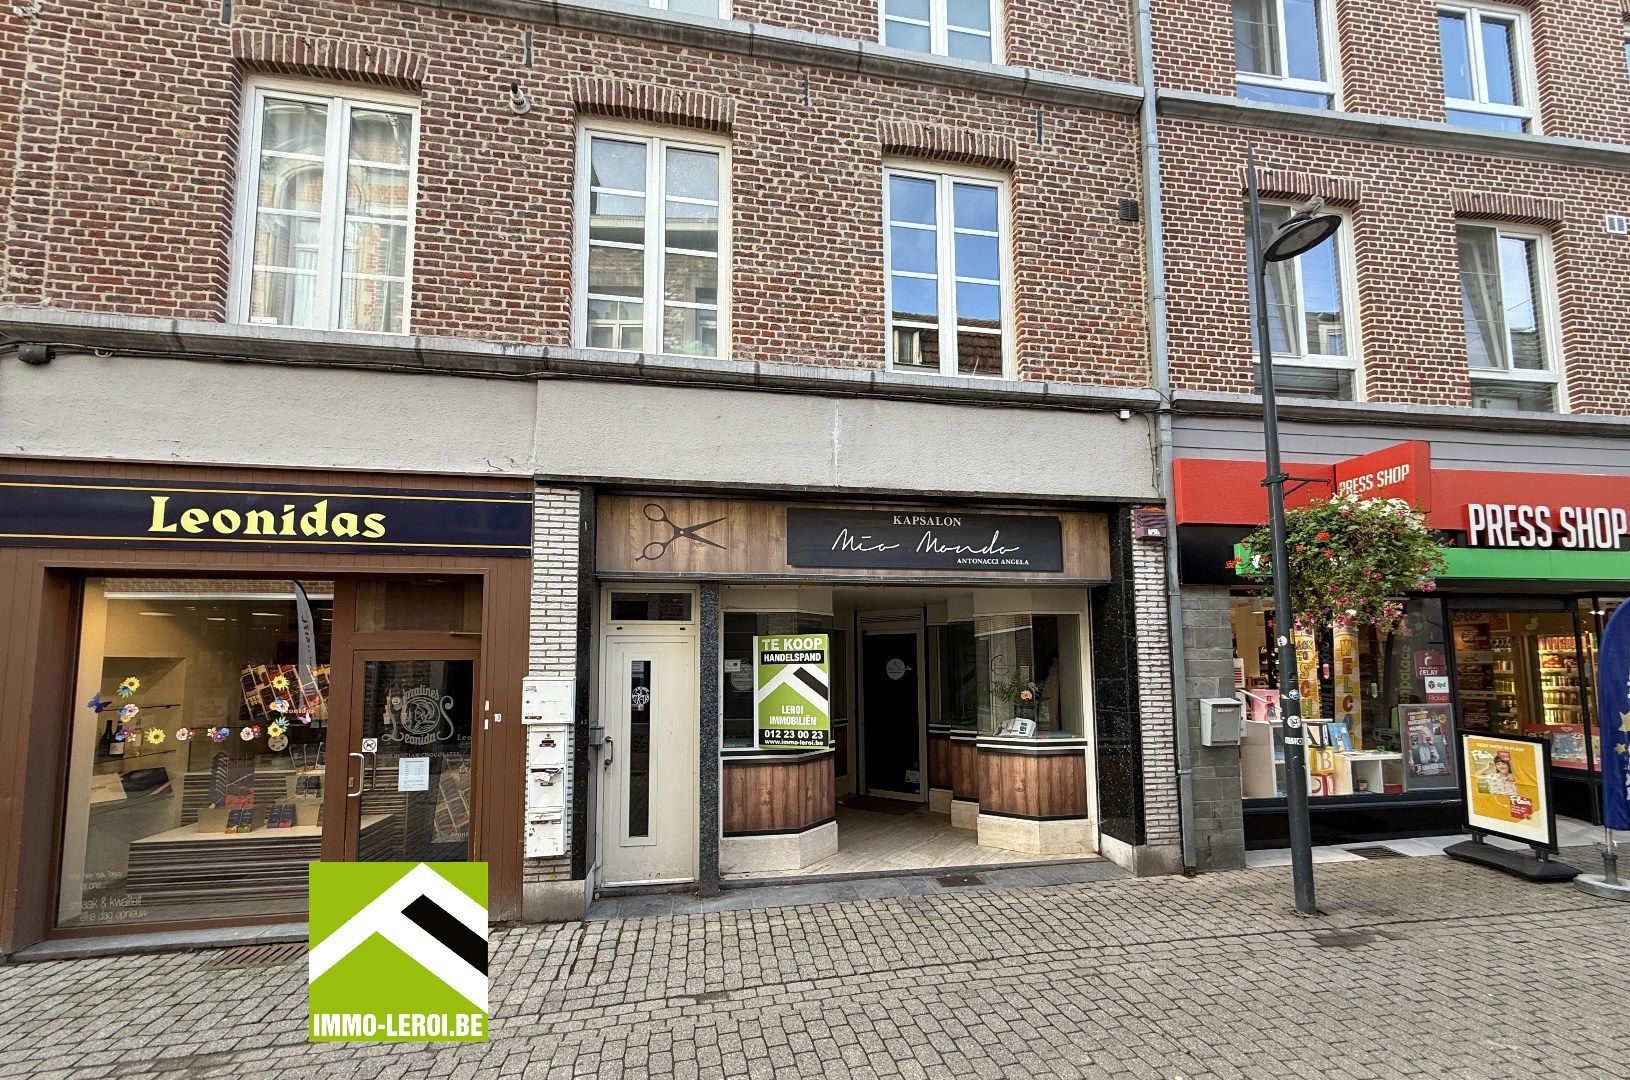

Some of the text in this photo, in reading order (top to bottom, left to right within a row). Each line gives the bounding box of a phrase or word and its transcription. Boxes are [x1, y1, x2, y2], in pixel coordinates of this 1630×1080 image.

[1339, 464, 1410, 497] PRESS SHOP
[148, 496, 386, 538] Leonidas
[892, 515, 962, 527] KAPSALON
[1467, 503, 1629, 549] PRESS SHOP
[831, 528, 1020, 554] Mio Mondo
[956, 558, 999, 566] ANTONACCI
[762, 637, 823, 651] TE KOOP
[763, 653, 822, 663] HANDELSPAND
[781, 705, 804, 715] LEROI
[769, 715, 817, 726] IMMOBILIËN
[764, 730, 824, 740] 012 23 00 23
